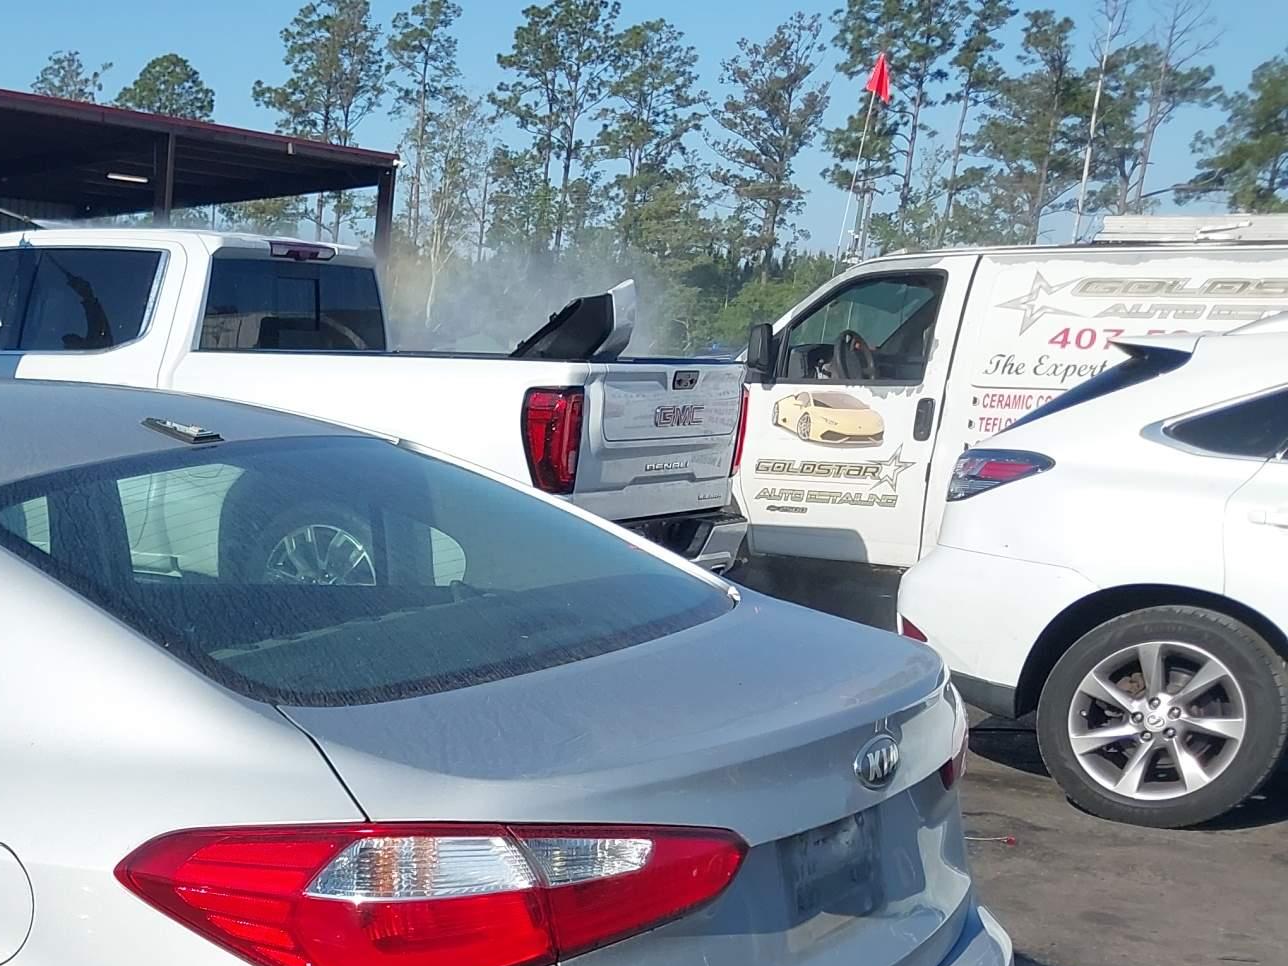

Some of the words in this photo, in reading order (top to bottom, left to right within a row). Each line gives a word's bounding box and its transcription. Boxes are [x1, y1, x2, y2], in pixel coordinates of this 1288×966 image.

[1093, 304, 1207, 319] AUTO
[983, 354, 1026, 376] The
[982, 393, 1032, 410] CERAMIC
[655, 405, 705, 428] GMC
[645, 460, 690, 472] DENALI
[754, 487, 805, 502] AUTO
[805, 490, 899, 508] DETAILING
[867, 743, 899, 781] KIA
